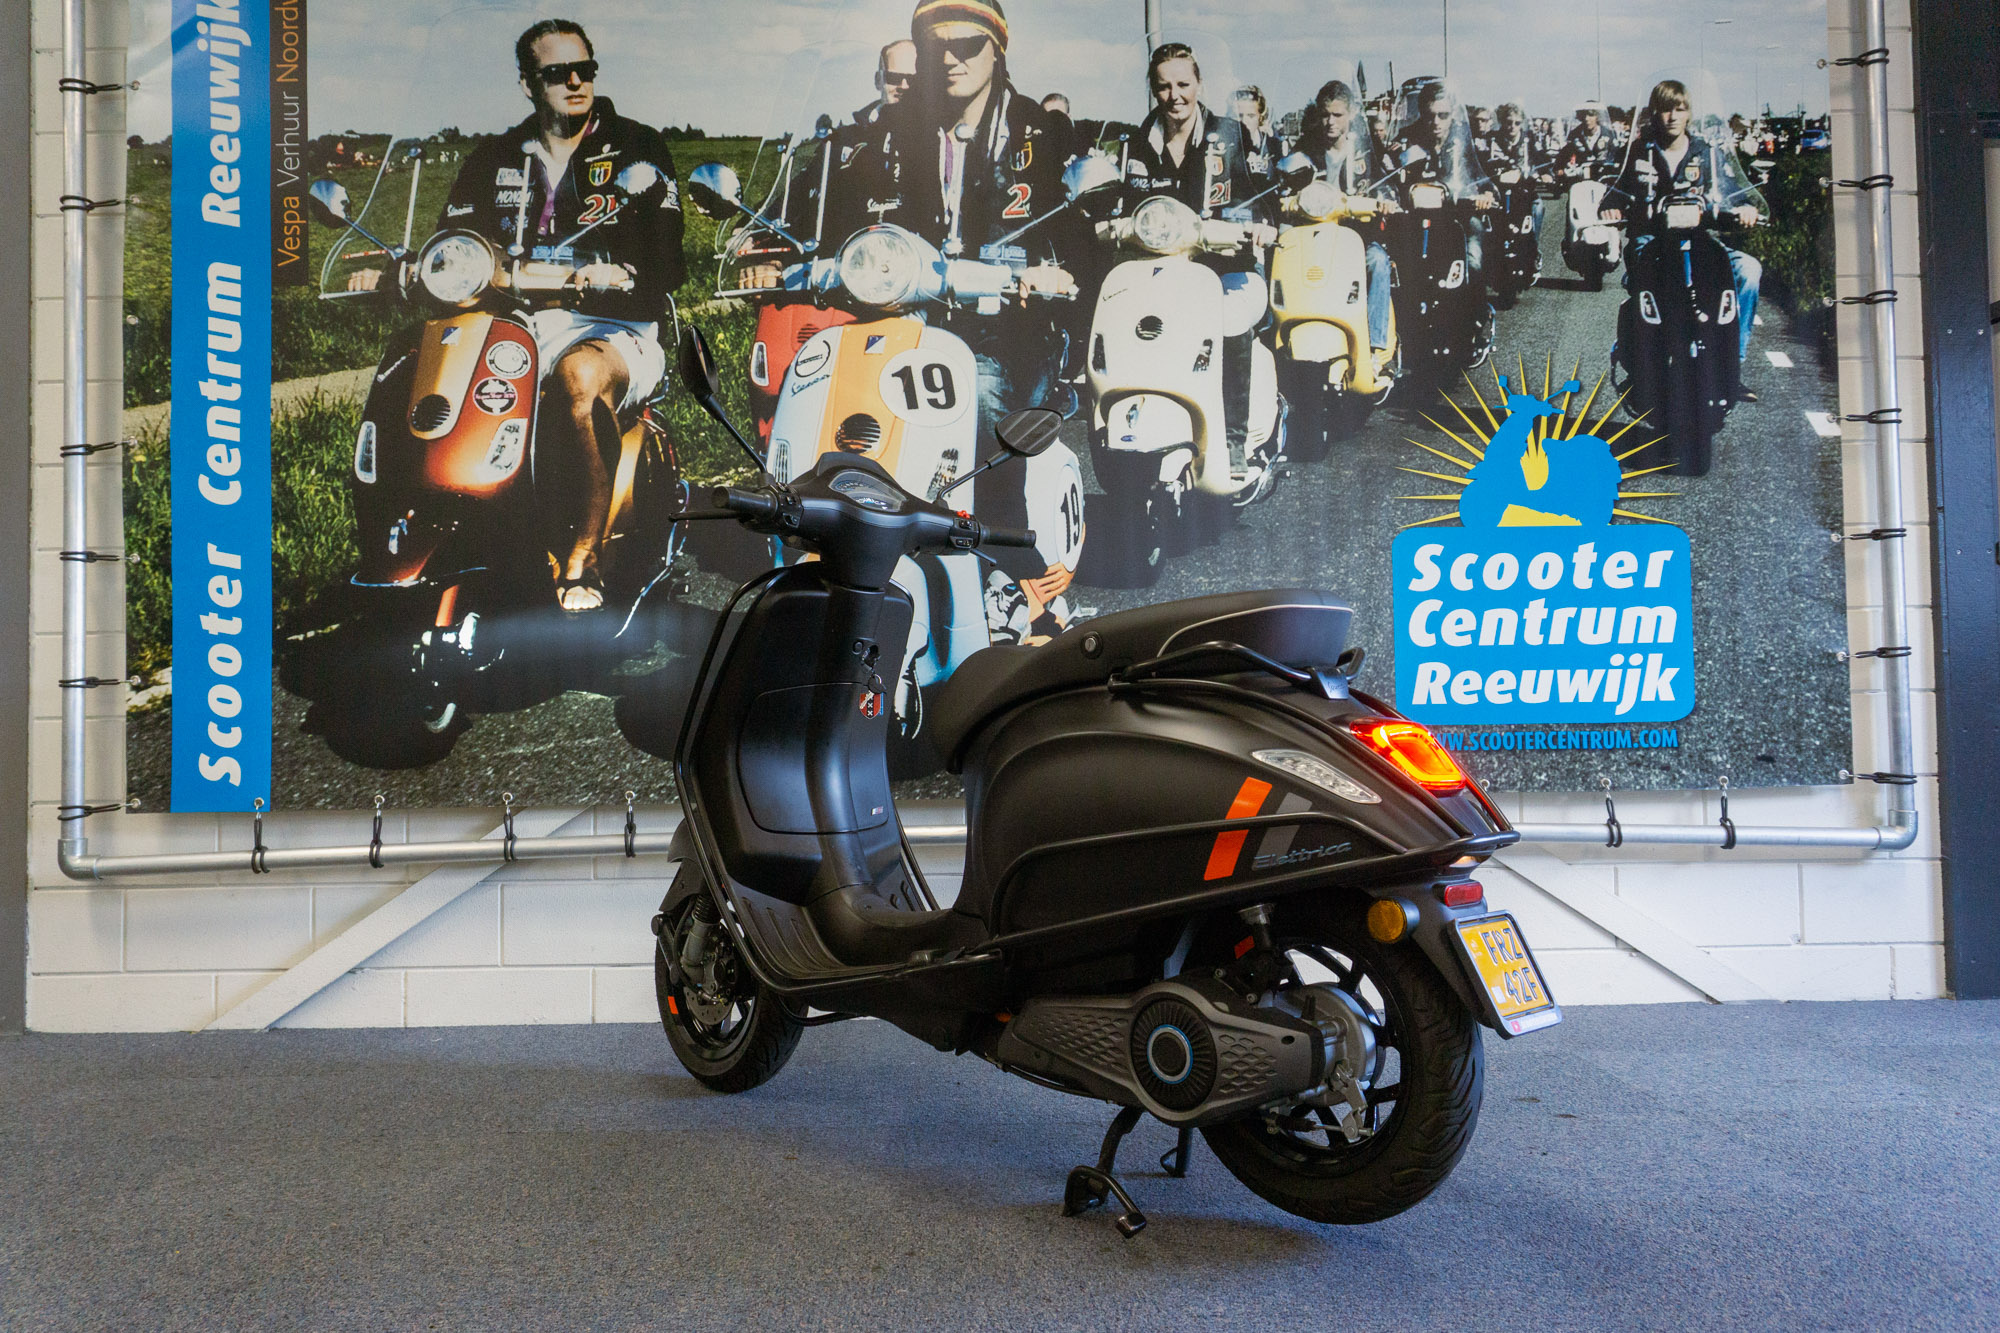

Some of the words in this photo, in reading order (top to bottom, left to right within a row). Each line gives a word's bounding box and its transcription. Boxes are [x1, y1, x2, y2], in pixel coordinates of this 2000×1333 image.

[196, 0, 252, 228] Reeuwijk
[275, 91, 300, 188] Verhuur
[277, 196, 306, 267] Vespa
[197, 262, 242, 506] Centrum
[891, 363, 957, 411] 19
[1060, 482, 1081, 554] 19
[1408, 541, 1674, 592] Scooter
[1408, 597, 1678, 648] Centrum
[198, 542, 243, 788] Scooter
[1411, 652, 1681, 716] Reeuwijk
